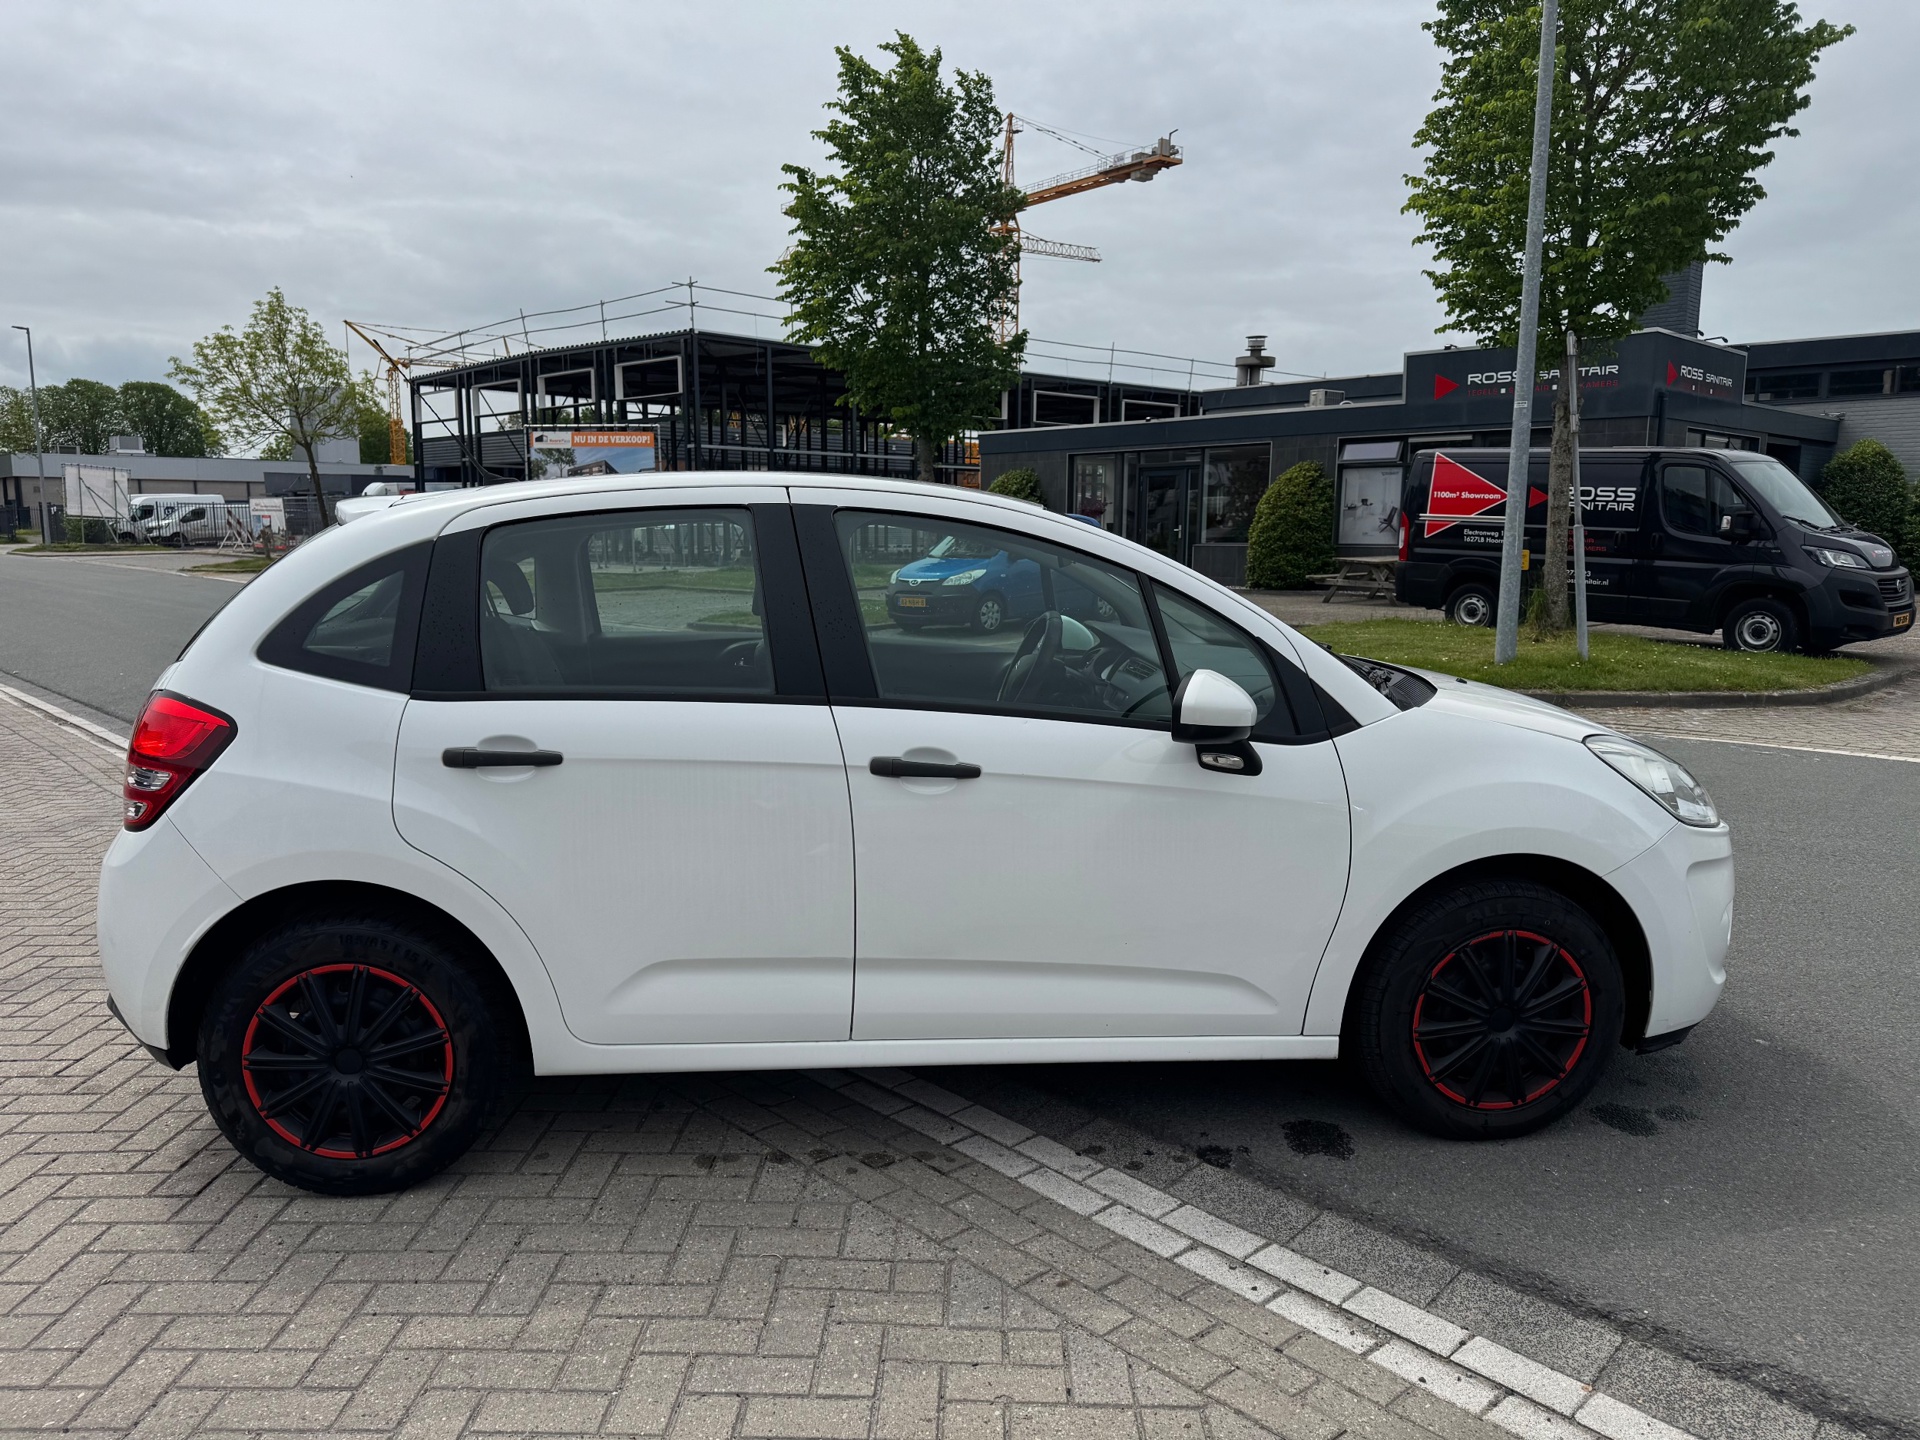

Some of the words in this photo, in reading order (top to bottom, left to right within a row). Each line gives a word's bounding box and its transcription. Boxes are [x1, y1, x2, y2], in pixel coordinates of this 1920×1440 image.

[1539, 365, 1619, 380] SATAIR
[1681, 365, 1704, 381] ROSS
[1706, 373, 1733, 387] SANITAIR
[574, 435, 586, 444] NU
[587, 435, 597, 444] IN
[598, 435, 609, 444] DE
[609, 435, 651, 444] VERKOOP!
[1461, 491, 1502, 500] Showroom
[1463, 528, 1499, 538] Electronweg
[1463, 535, 1485, 543] 1627LB
